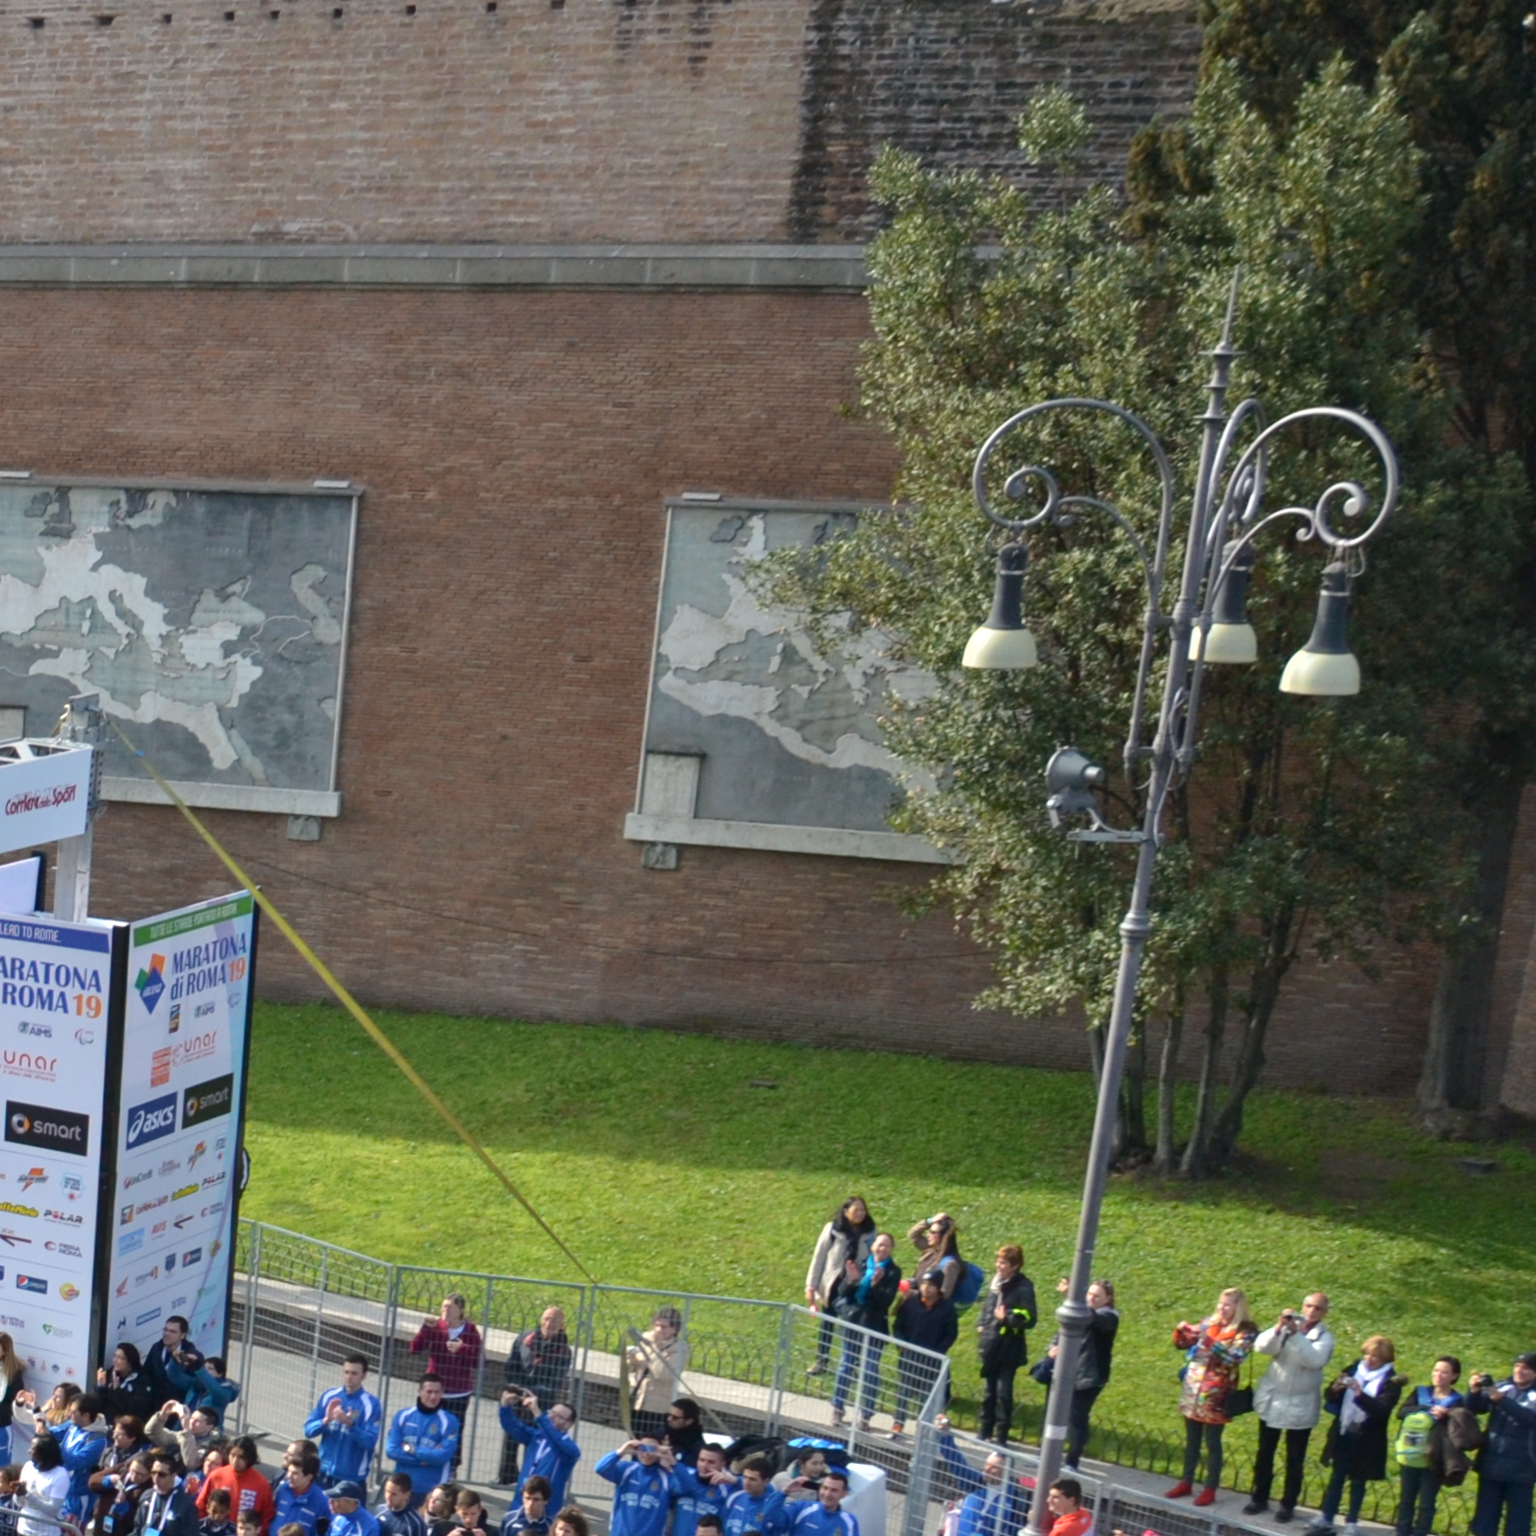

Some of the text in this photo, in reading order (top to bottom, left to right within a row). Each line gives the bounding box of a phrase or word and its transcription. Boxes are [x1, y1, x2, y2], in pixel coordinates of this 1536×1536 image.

[0, 923, 20, 936] LEAD
[22, 926, 33, 938] TO
[172, 933, 246, 975] MARATONA
[170, 957, 246, 1000] di ROMA 19
[2, 982, 68, 1014] ROMA
[73, 993, 102, 1019] 19
[142, 984, 162, 998] acea
[184, 1031, 217, 1053] unar
[3, 1049, 57, 1072] unar
[199, 1087, 229, 1109] smart
[143, 1105, 174, 1133] asics
[33, 1120, 82, 1141] smart
[44, 1209, 83, 1224] POLAR
